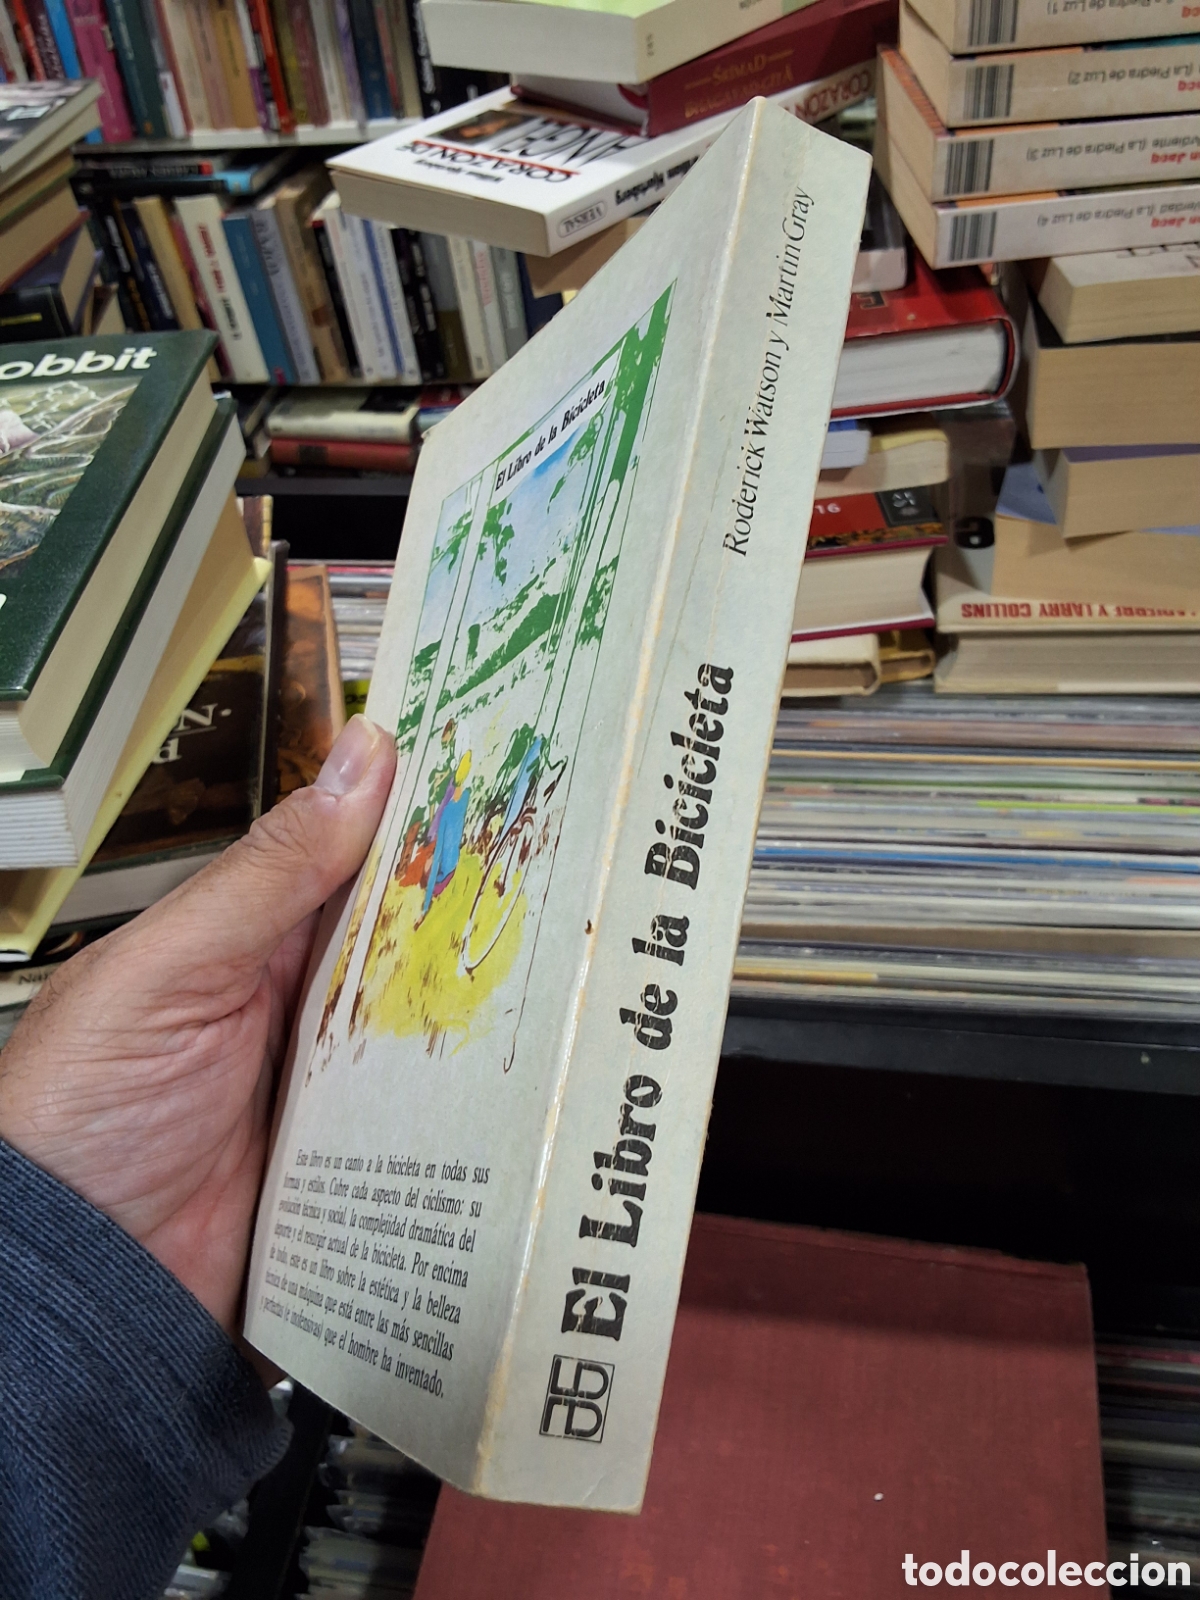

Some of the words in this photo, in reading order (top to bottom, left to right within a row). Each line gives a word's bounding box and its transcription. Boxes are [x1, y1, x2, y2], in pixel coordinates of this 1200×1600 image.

[782, 186, 815, 242] Gray
[765, 244, 801, 326] Martin
[769, 330, 790, 352] y
[744, 351, 782, 436] Watson
[495, 468, 506, 491] El
[506, 451, 532, 482] Libro
[534, 435, 546, 456] de
[548, 425, 558, 445] la
[561, 380, 605, 432] Bicicleta
[722, 442, 766, 557] Roderick
[961, 602, 1032, 618] COLLINS
[1039, 602, 1092, 618] LARRY
[643, 663, 734, 891] Bicicleta
[631, 914, 690, 966] la
[619, 982, 678, 1051] de
[345, 1156, 364, 1171] canto
[375, 1154, 383, 1173] la
[387, 1155, 421, 1177] bicicleta
[425, 1163, 436, 1179] en
[441, 1159, 468, 1182] todas
[472, 1166, 490, 1184] sus
[578, 1074, 662, 1248] Libro
[329, 1177, 349, 1197] Cubre
[352, 1181, 368, 1200] cada
[371, 1186, 401, 1207] aspecto
[405, 1186, 420, 1208] del
[422, 1188, 465, 1215] ciclismo:
[469, 1200, 483, 1218] su
[349, 1208, 357, 1227] la
[359, 1213, 408, 1238] complejidad
[408, 1218, 455, 1248] dramática
[459, 1227, 476, 1253] del
[327, 1235, 349, 1255] actual
[350, 1237, 359, 1258] de
[360, 1240, 369, 1261] la
[371, 1242, 407, 1271] bicicleta.
[411, 1252, 429, 1277] Por
[431, 1260, 469, 1288] encima
[336, 1265, 356, 1288] sobre
[358, 1270, 367, 1292] la
[369, 1277, 400, 1303] estética
[401, 1290, 409, 1311] y
[412, 1287, 422, 1311] la
[426, 1290, 461, 1324] belleza
[561, 1266, 630, 1342] El
[338, 1299, 354, 1319] está
[354, 1307, 375, 1329] entre
[376, 1310, 389, 1335] las
[391, 1318, 410, 1344] más
[412, 1329, 454, 1361] sencillas
[324, 1327, 337, 1347] que
[339, 1330, 347, 1351] el
[347, 1332, 379, 1366] hombre
[381, 1347, 393, 1373] ha
[395, 1353, 444, 1398] inventado.
